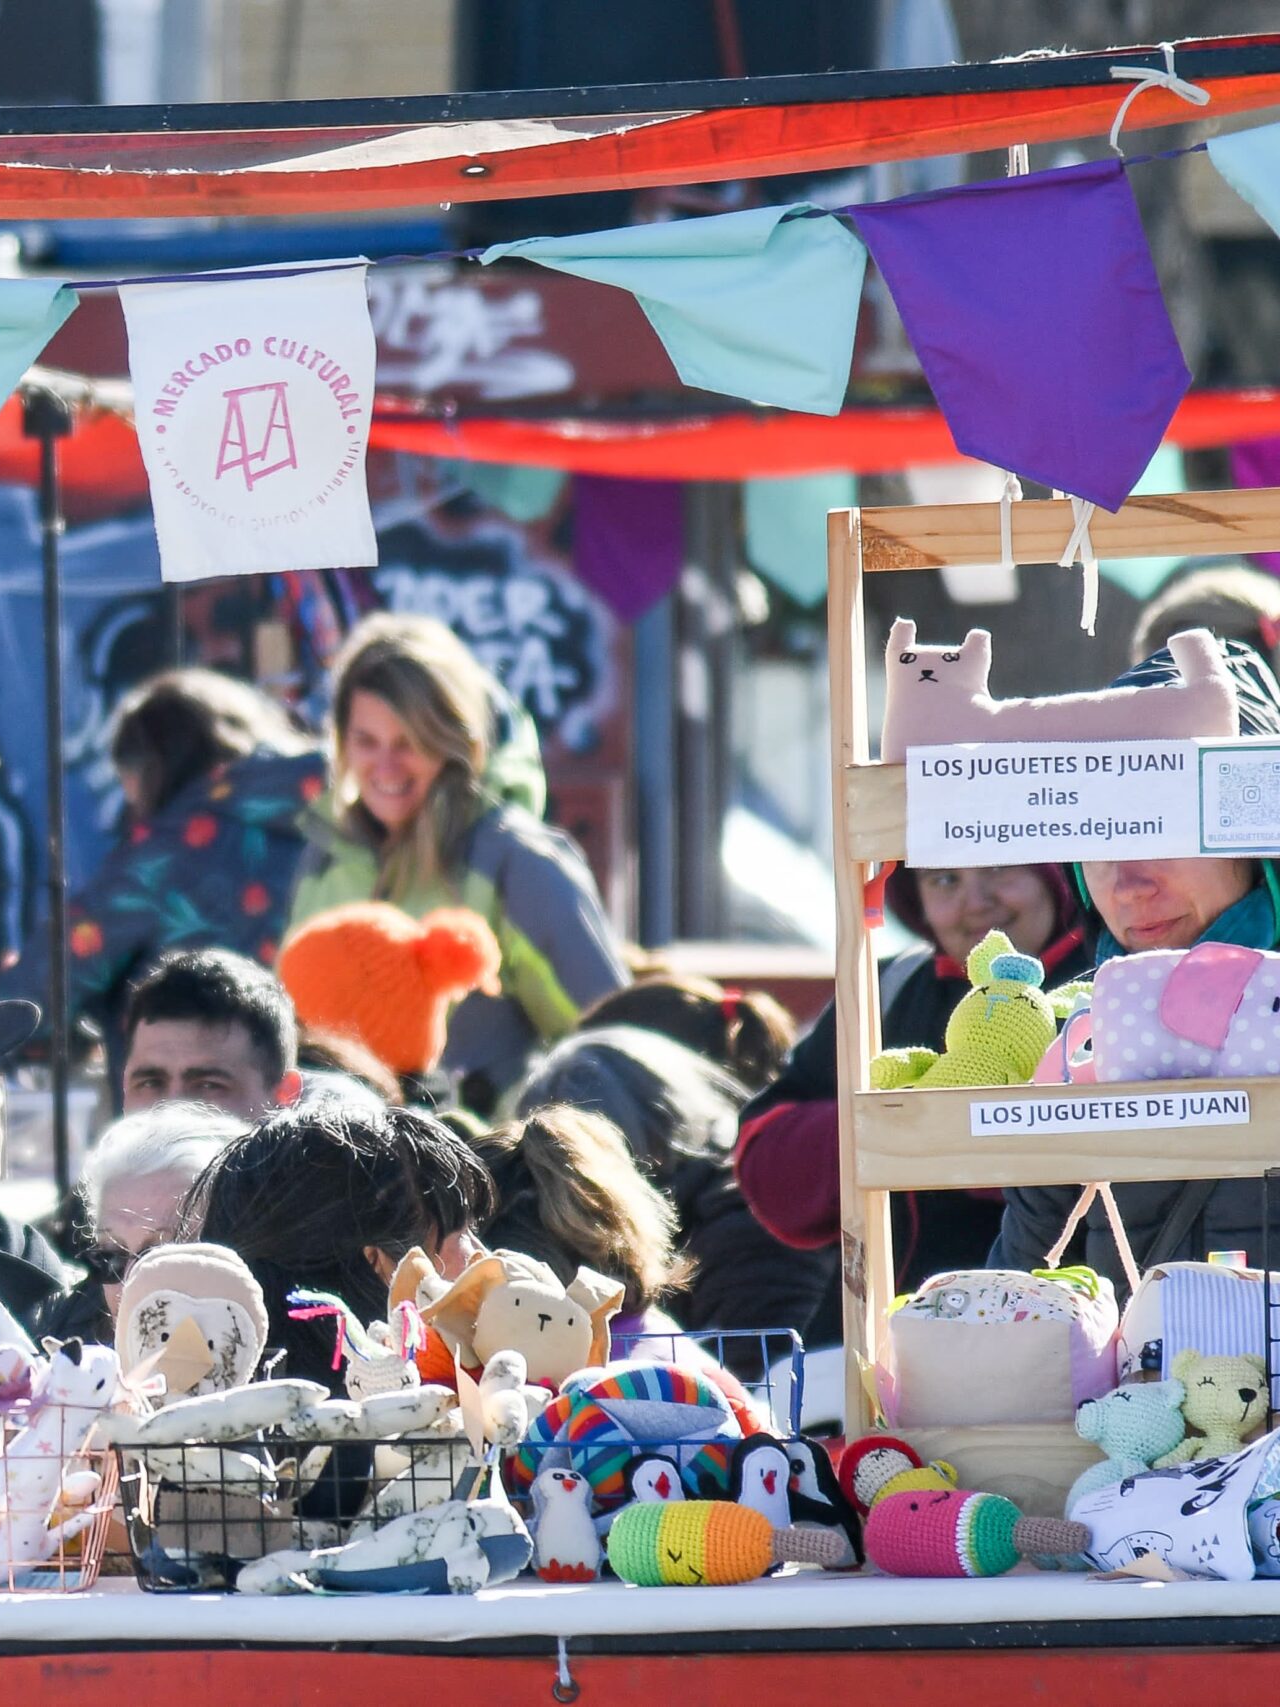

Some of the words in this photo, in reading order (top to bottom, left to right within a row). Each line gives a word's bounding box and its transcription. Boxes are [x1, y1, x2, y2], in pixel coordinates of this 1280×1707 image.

[152, 338, 252, 418] MERCADO
[263, 336, 362, 420] CULTURAL
[921, 759, 963, 778] LOS
[968, 755, 1078, 779] JUGUETES
[1085, 755, 1113, 773] DE
[1118, 753, 1184, 776] JUANI
[1027, 787, 1079, 806] alias
[944, 816, 1163, 843] losjuguetes.dejuani
[980, 1106, 1022, 1125] LOS
[1027, 1100, 1138, 1127] JUGUETES
[1146, 1099, 1174, 1117] DE
[1179, 1096, 1247, 1120] JUANI
